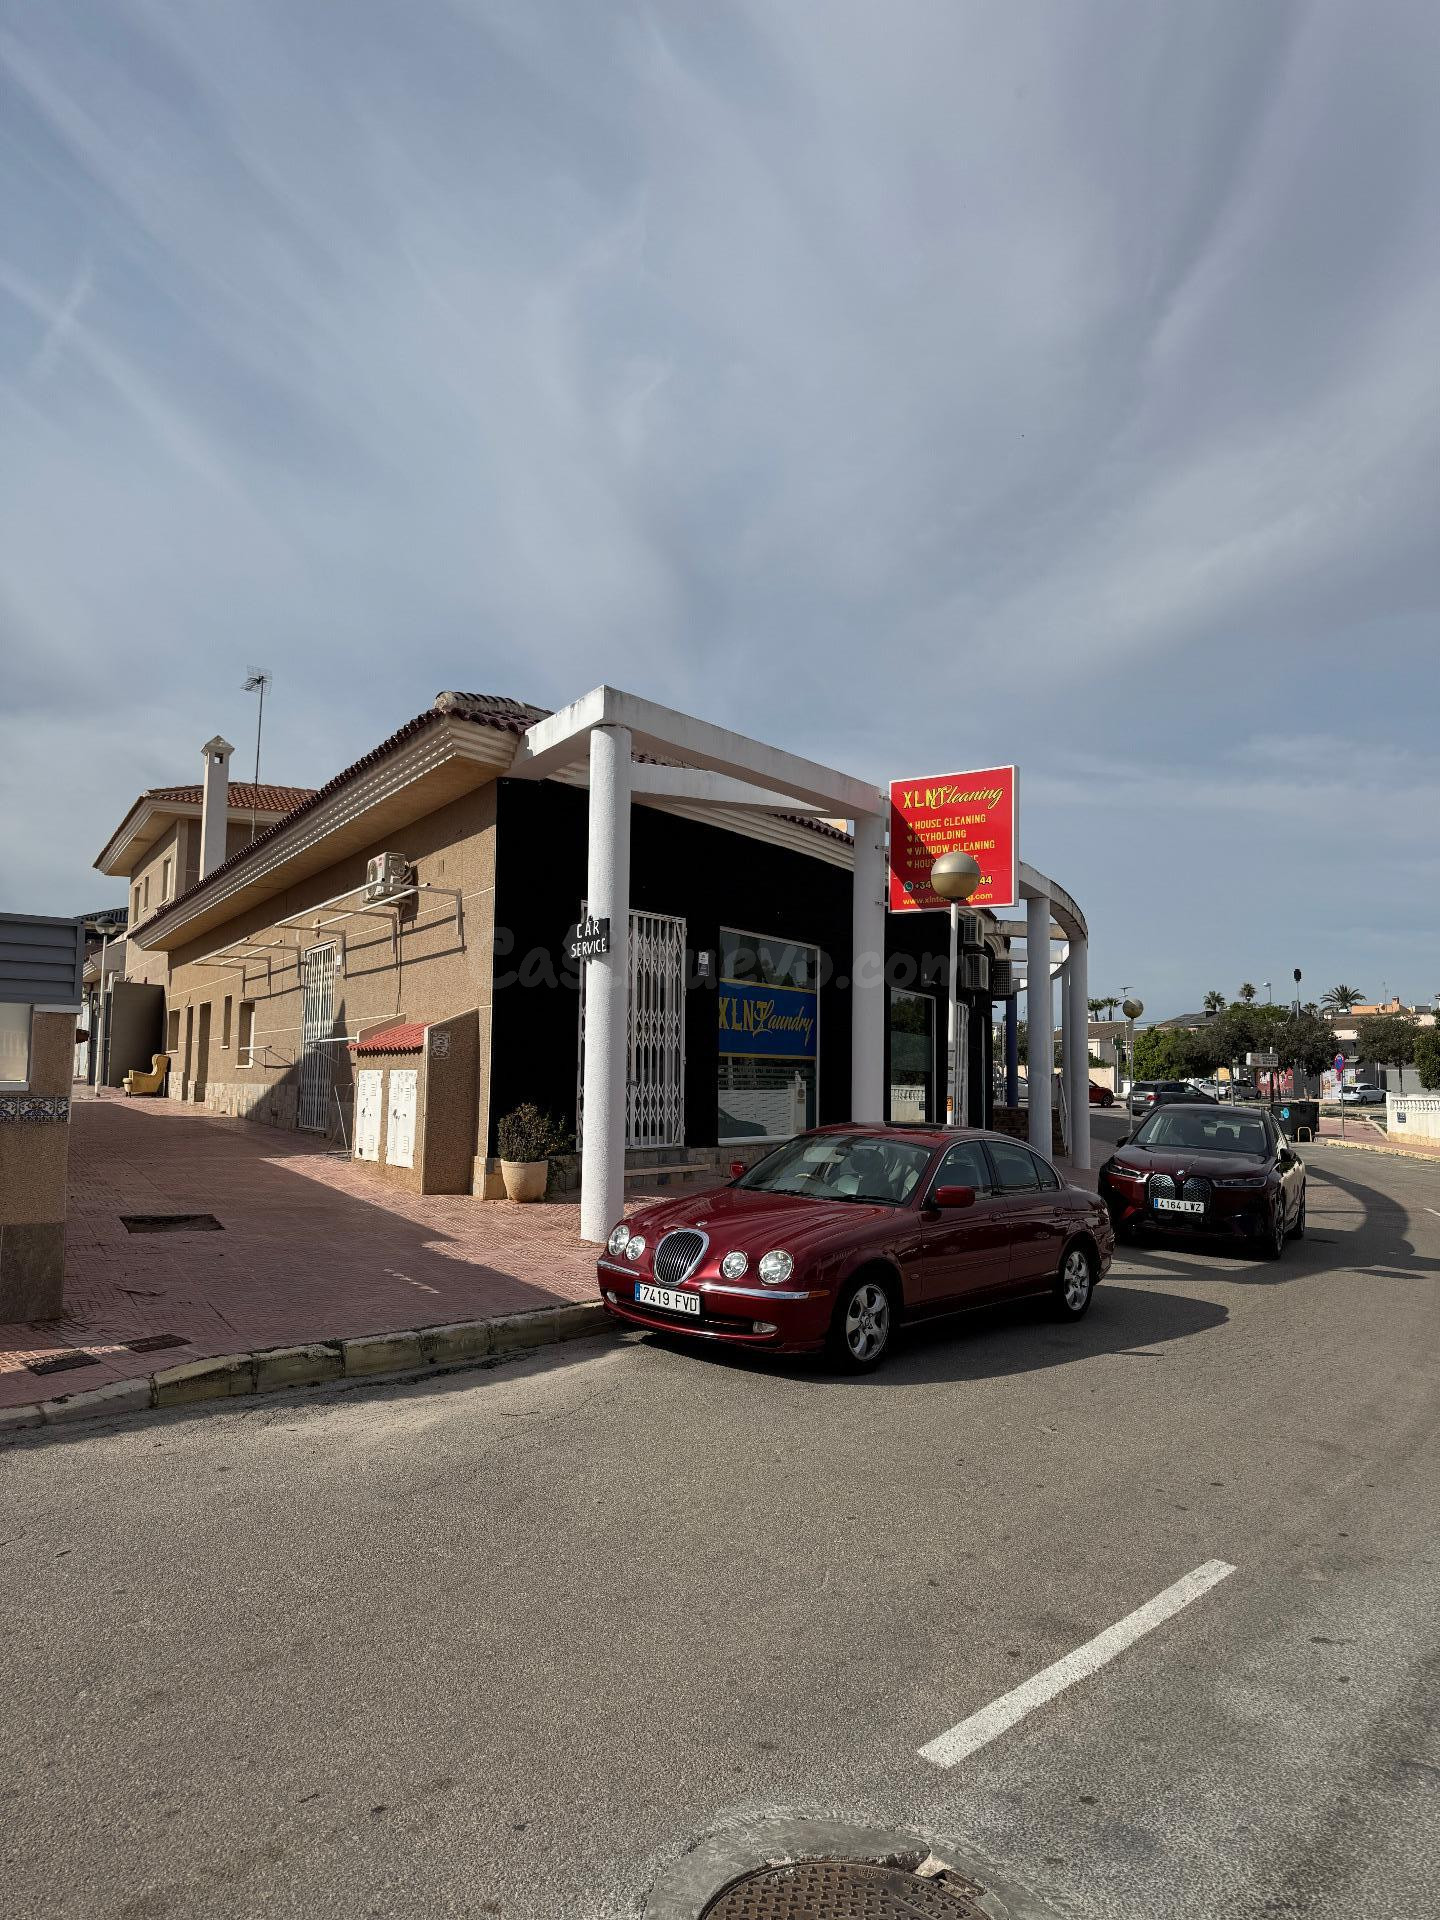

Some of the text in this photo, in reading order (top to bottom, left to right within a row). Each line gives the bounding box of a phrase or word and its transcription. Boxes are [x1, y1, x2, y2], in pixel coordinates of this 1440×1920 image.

[903, 785, 1004, 810] XLNT Cleaning
[915, 814, 986, 830] HOUSE CLEANING
[914, 830, 967, 842] KEYHOLDING
[914, 840, 995, 855] WINDOW CLEANING
[914, 858, 937, 869] HOUS
[915, 881, 931, 890] +34
[576, 920, 600, 938] CAR
[570, 938, 607, 958] SERVICE
[719, 997, 814, 1047] XLNT Laundry
[1160, 1200, 1201, 1211] 4164 LWZ
[643, 1286, 697, 1312] 7419 FVD
